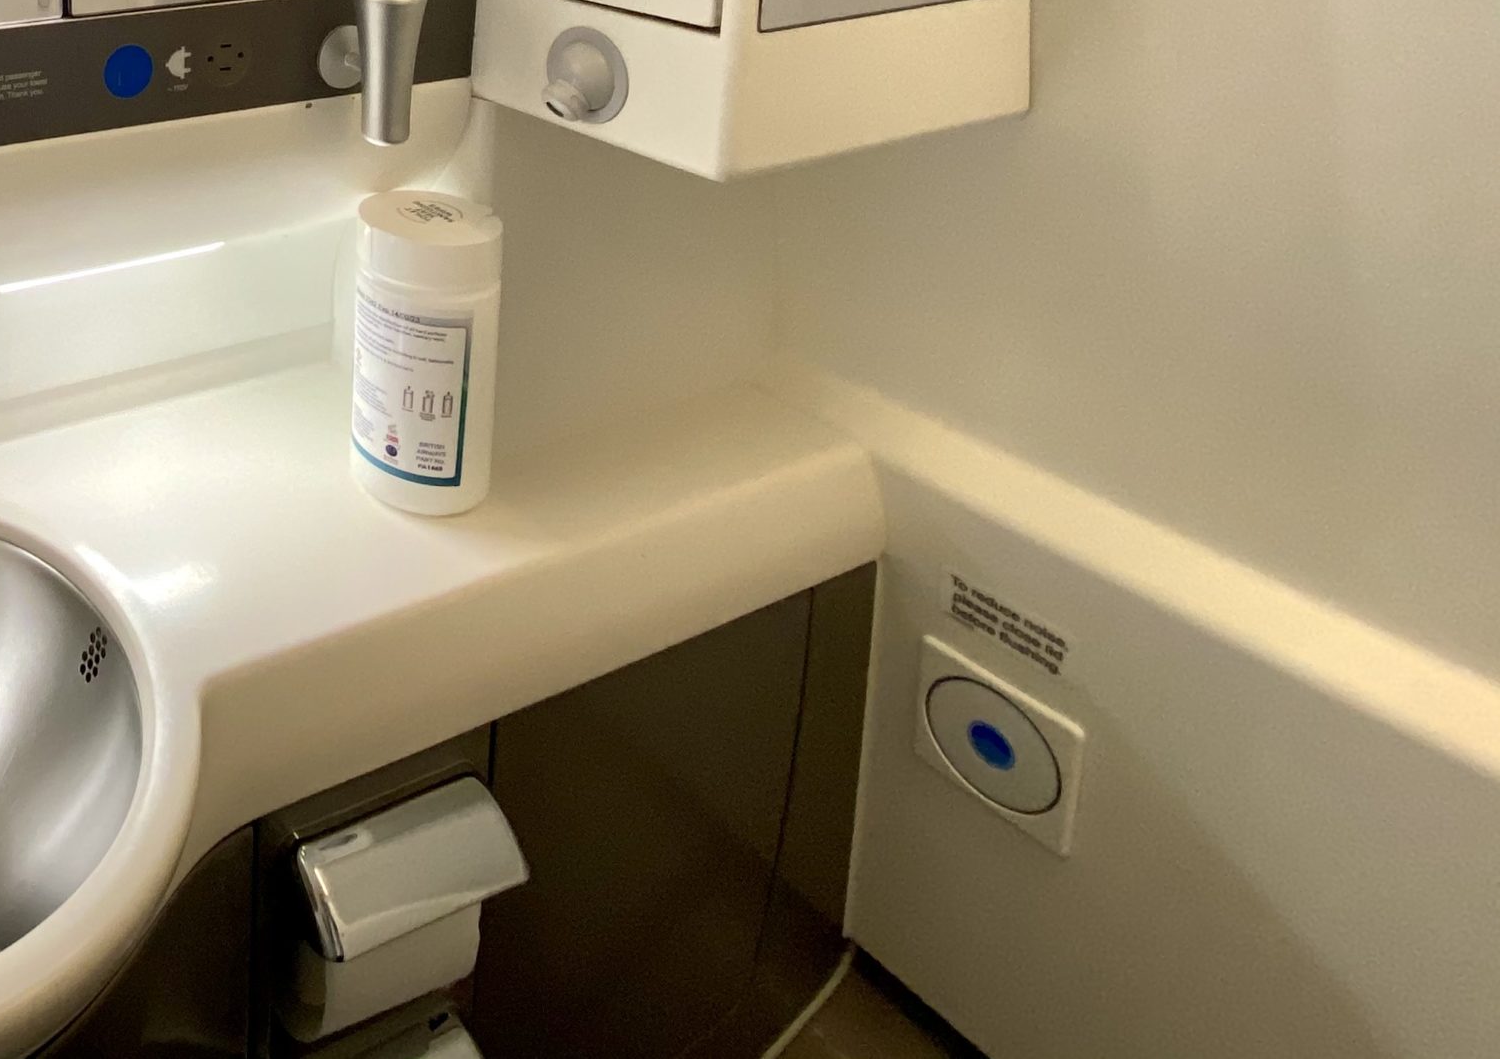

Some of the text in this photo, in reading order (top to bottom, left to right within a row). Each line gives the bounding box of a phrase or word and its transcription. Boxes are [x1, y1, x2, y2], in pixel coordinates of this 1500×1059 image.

[951, 574, 1068, 653] To reduce noise,
[952, 604, 996, 636] before
[1002, 621, 1041, 648] close
[1045, 645, 1063, 662] lid
